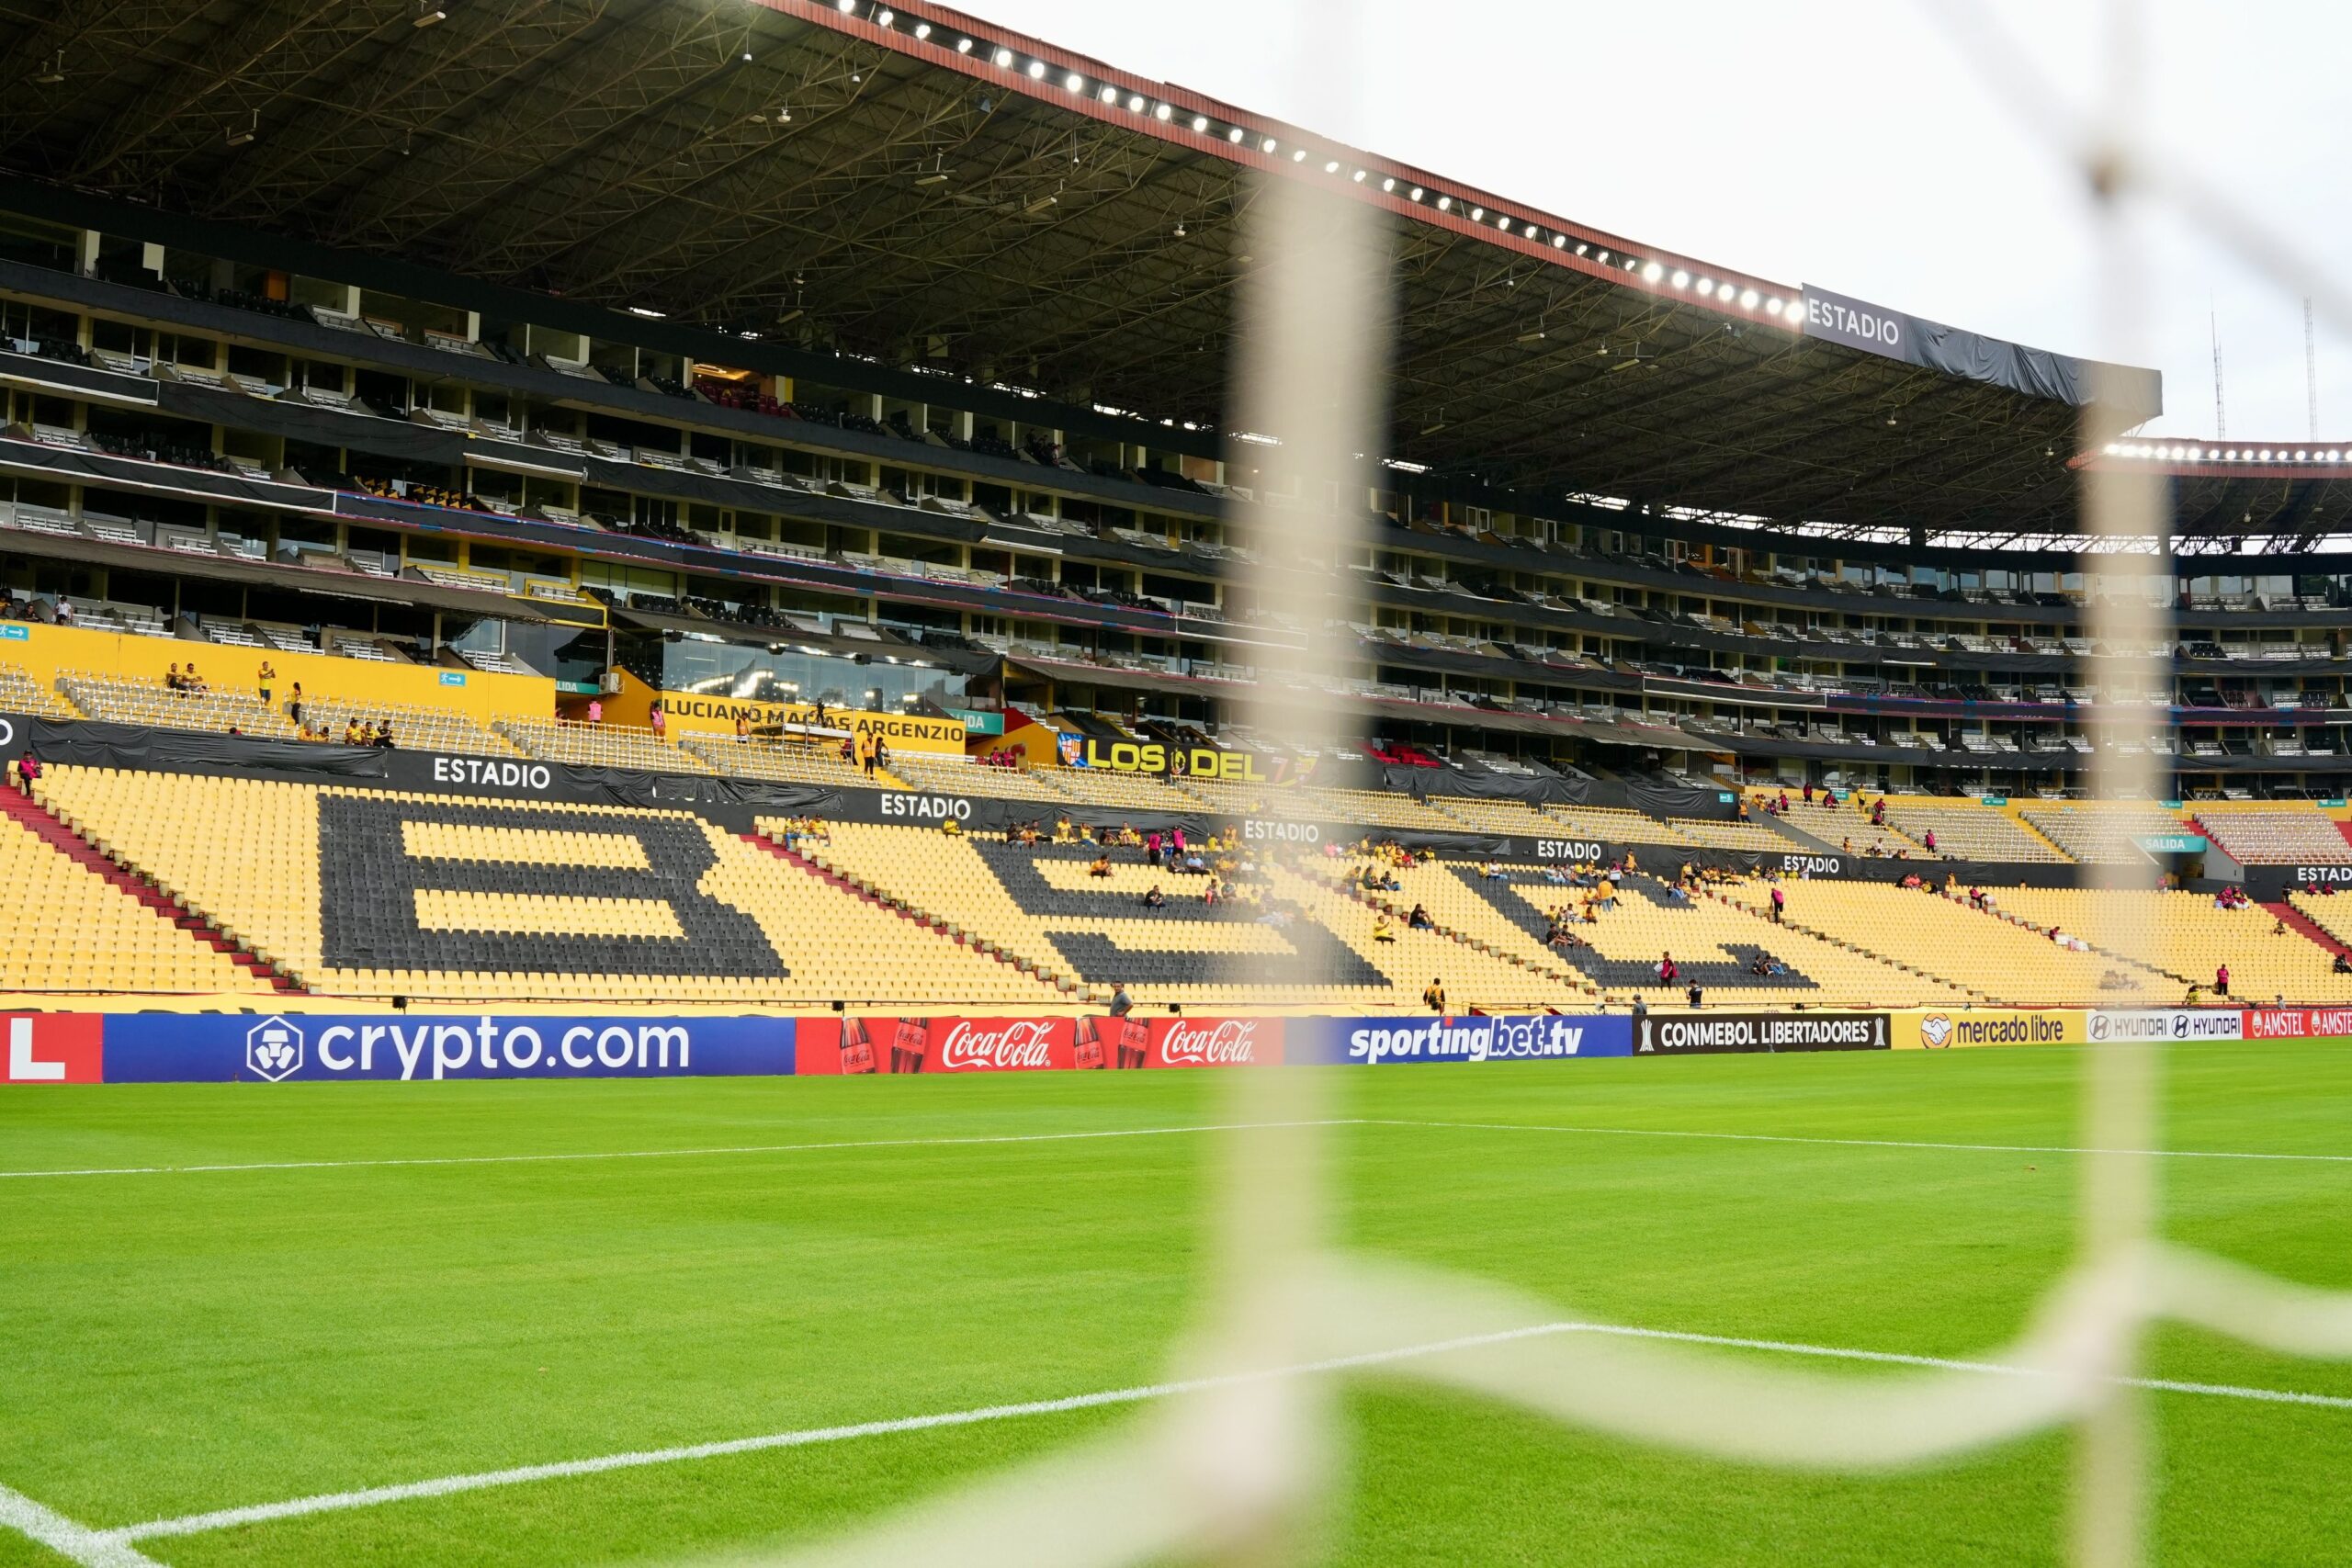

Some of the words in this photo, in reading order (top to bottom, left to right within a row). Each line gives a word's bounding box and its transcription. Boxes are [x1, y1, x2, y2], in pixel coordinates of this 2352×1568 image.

[1808, 298, 1899, 345] ESTADIO
[555, 680, 578, 693] LIDA
[664, 699, 762, 723] LUCIANO
[767, 710, 851, 732] MACAS
[856, 718, 963, 742] ARGENZIO
[435, 757, 550, 790] ESTADIO
[1087, 739, 1166, 772] LOS
[1190, 749, 1266, 782] DEL
[881, 794, 971, 820] ESTADIO
[1245, 819, 1319, 842] ESTADIO
[2145, 838, 2186, 850] SALIDA
[1538, 840, 1601, 861] ESTADIO
[1784, 855, 1839, 874] ESTADIO
[2298, 867, 2352, 882] ESTAD
[1661, 1021, 1758, 1047] CONMEBOL
[1761, 1020, 1870, 1044] LIBERTADORES
[1958, 1015, 2028, 1043] mercado
[2031, 1014, 2064, 1042] libre
[2115, 1017, 2167, 1036] HYUNDAI
[2194, 1017, 2241, 1035] HYUNDAI
[2264, 1011, 2305, 1036] AMSTEL
[9, 1017, 65, 1080] L
[318, 1016, 690, 1081] crypto.com
[943, 1021, 1056, 1067] Coca-Cola
[1161, 1020, 1258, 1065] Coca-Cola
[1349, 1015, 1584, 1065] sportingbet.tv
